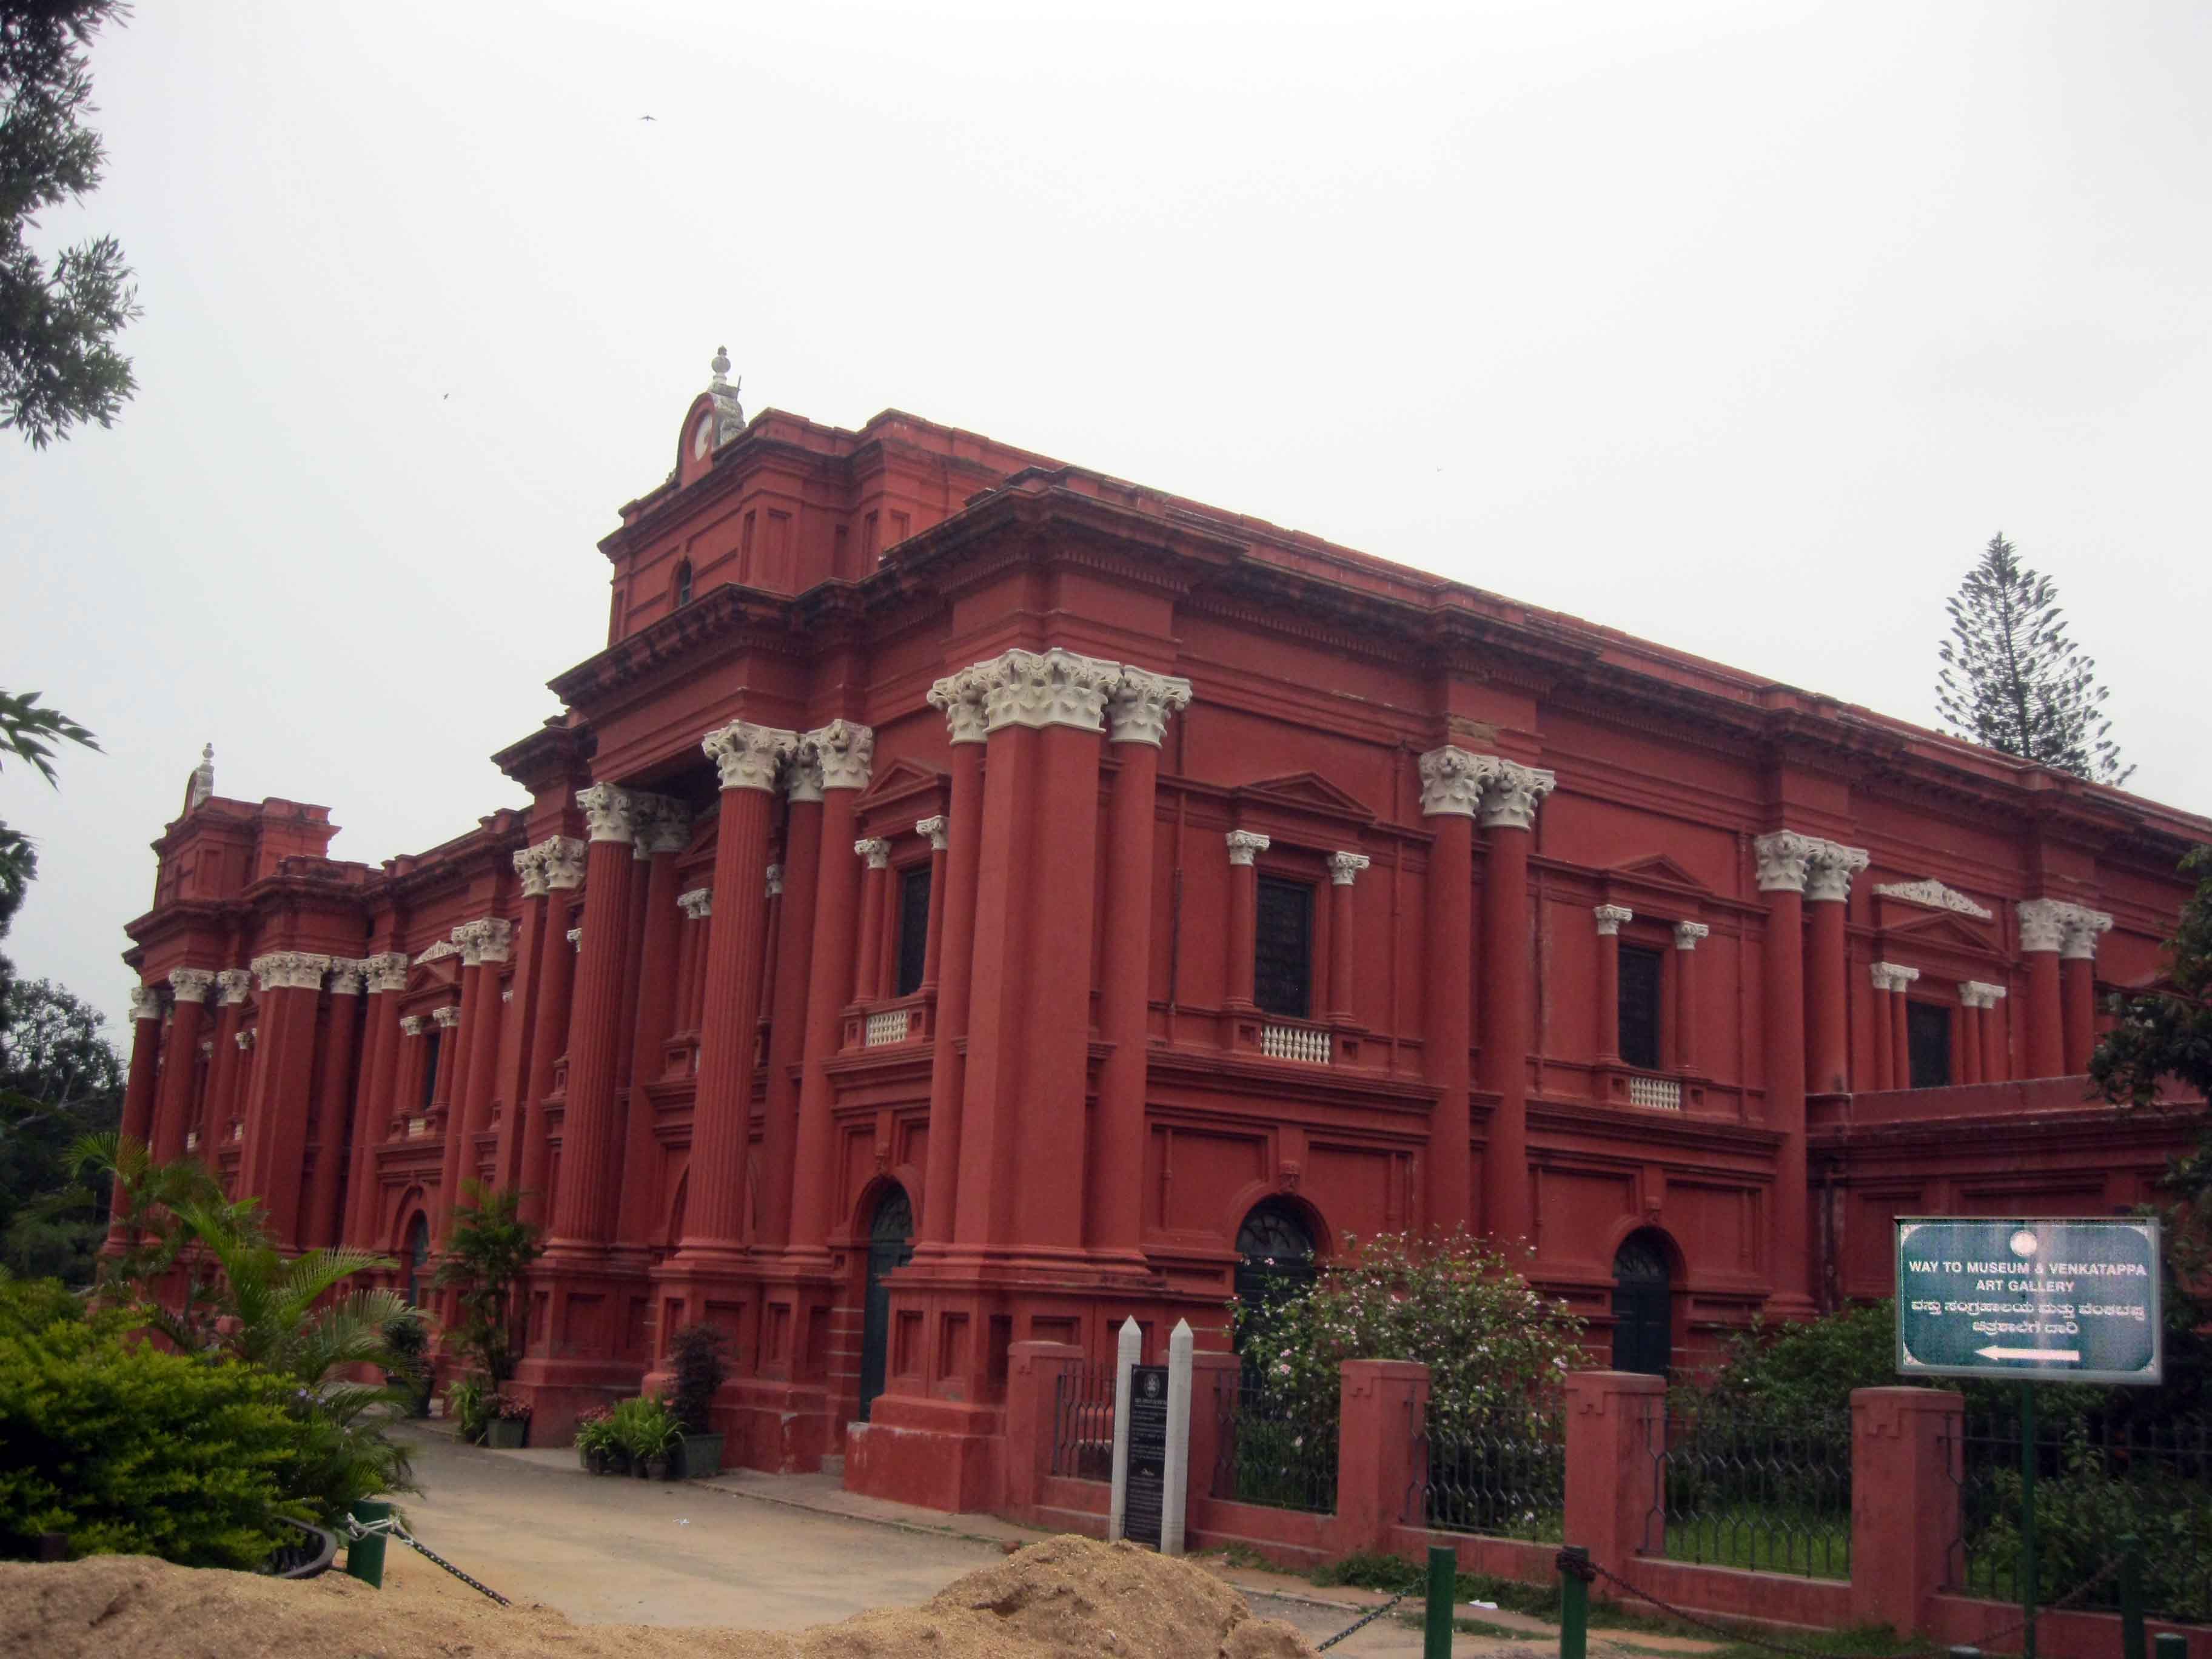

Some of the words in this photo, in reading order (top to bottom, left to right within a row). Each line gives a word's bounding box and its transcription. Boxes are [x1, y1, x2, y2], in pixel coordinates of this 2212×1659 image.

[1909, 1261, 1939, 1273] WAY
[1943, 1261, 1962, 1273] TO
[1967, 1262, 2029, 1274] MUSEUM
[2034, 1262, 2044, 1274] &
[2049, 1262, 2147, 1276] VENKATAPPA
[1976, 1280, 2003, 1291] ART
[2008, 1281, 2075, 1292] GALLERY
